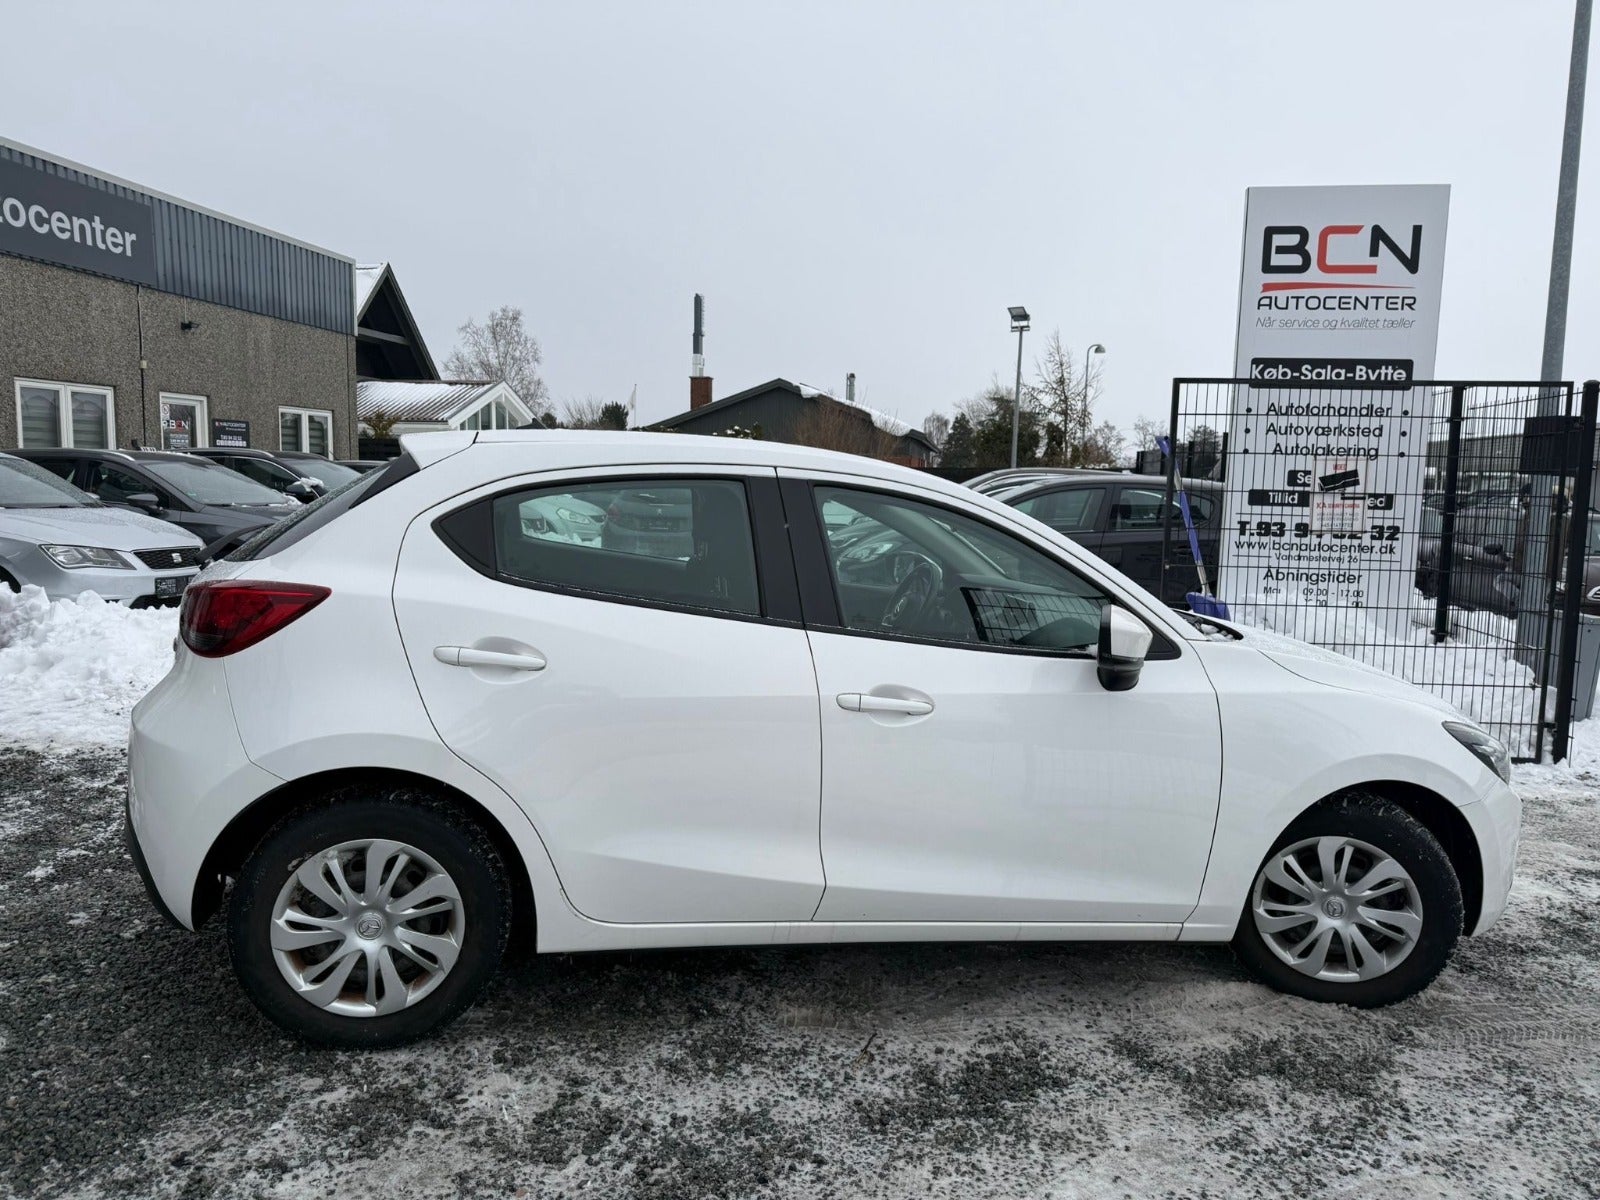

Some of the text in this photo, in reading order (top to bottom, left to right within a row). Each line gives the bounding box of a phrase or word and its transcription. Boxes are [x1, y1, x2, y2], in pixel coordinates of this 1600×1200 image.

[0, 197, 137, 257] ocenter
[1261, 224, 1423, 275] BCN
[1257, 296, 1417, 311] AUTOCENTER
[1256, 317, 1417, 331] Når service og kvalitet tæller
[1266, 402, 1392, 417] Autoforhandler
[1265, 422, 1384, 438] Autoværksted
[1272, 443, 1379, 461] Autolakering
[1268, 492, 1299, 504] Tillid
[1237, 521, 1286, 537] T.93
[1370, 525, 1401, 541] 32
[1234, 540, 1396, 555] www.bcnautocenter.dk
[1274, 553, 1345, 563] Vandmestervej
[1263, 565, 1363, 585] Åbningstider
